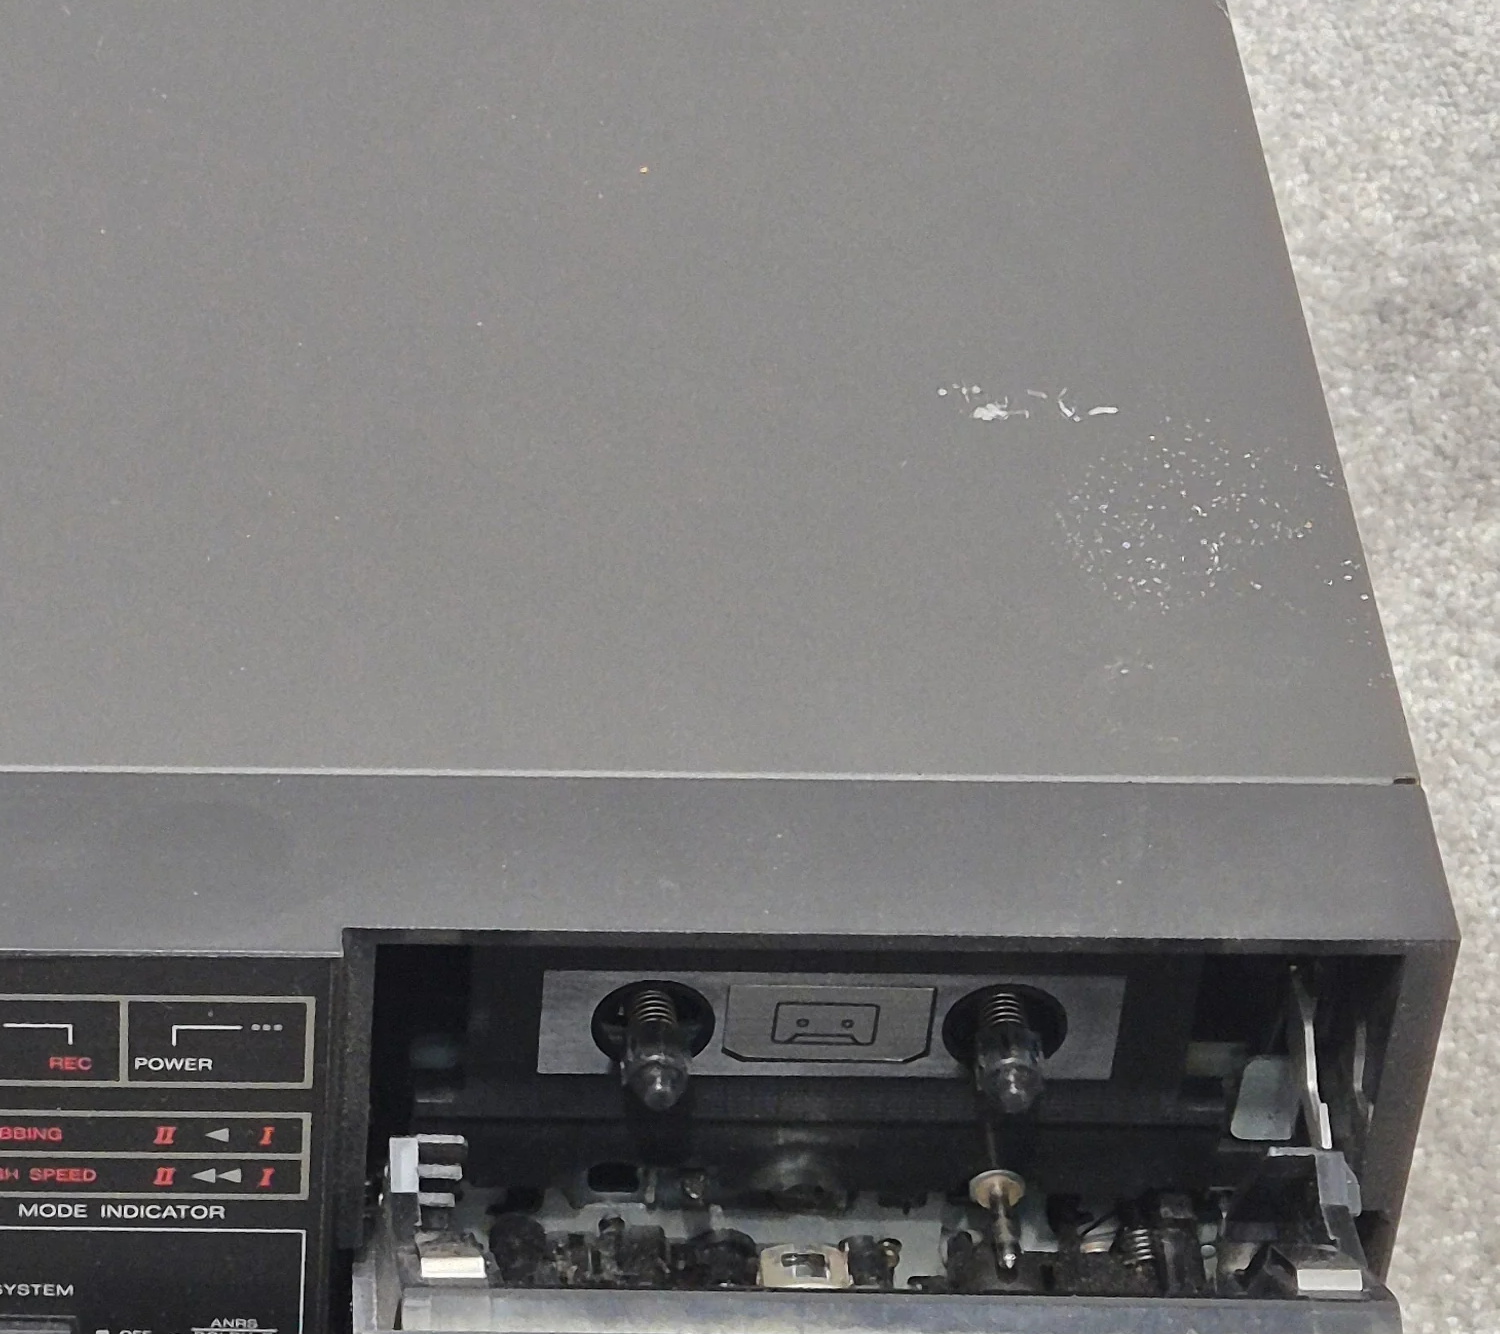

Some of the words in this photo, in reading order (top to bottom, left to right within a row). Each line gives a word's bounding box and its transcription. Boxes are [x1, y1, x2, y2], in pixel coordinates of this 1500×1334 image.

[48, 1056, 93, 1071] REC
[133, 1056, 213, 1072] POWER
[28, 1168, 97, 1183] SPEED
[17, 1203, 89, 1220] MODE
[100, 1204, 226, 1221] INDICATOR
[210, 1317, 259, 1329] ANRS
